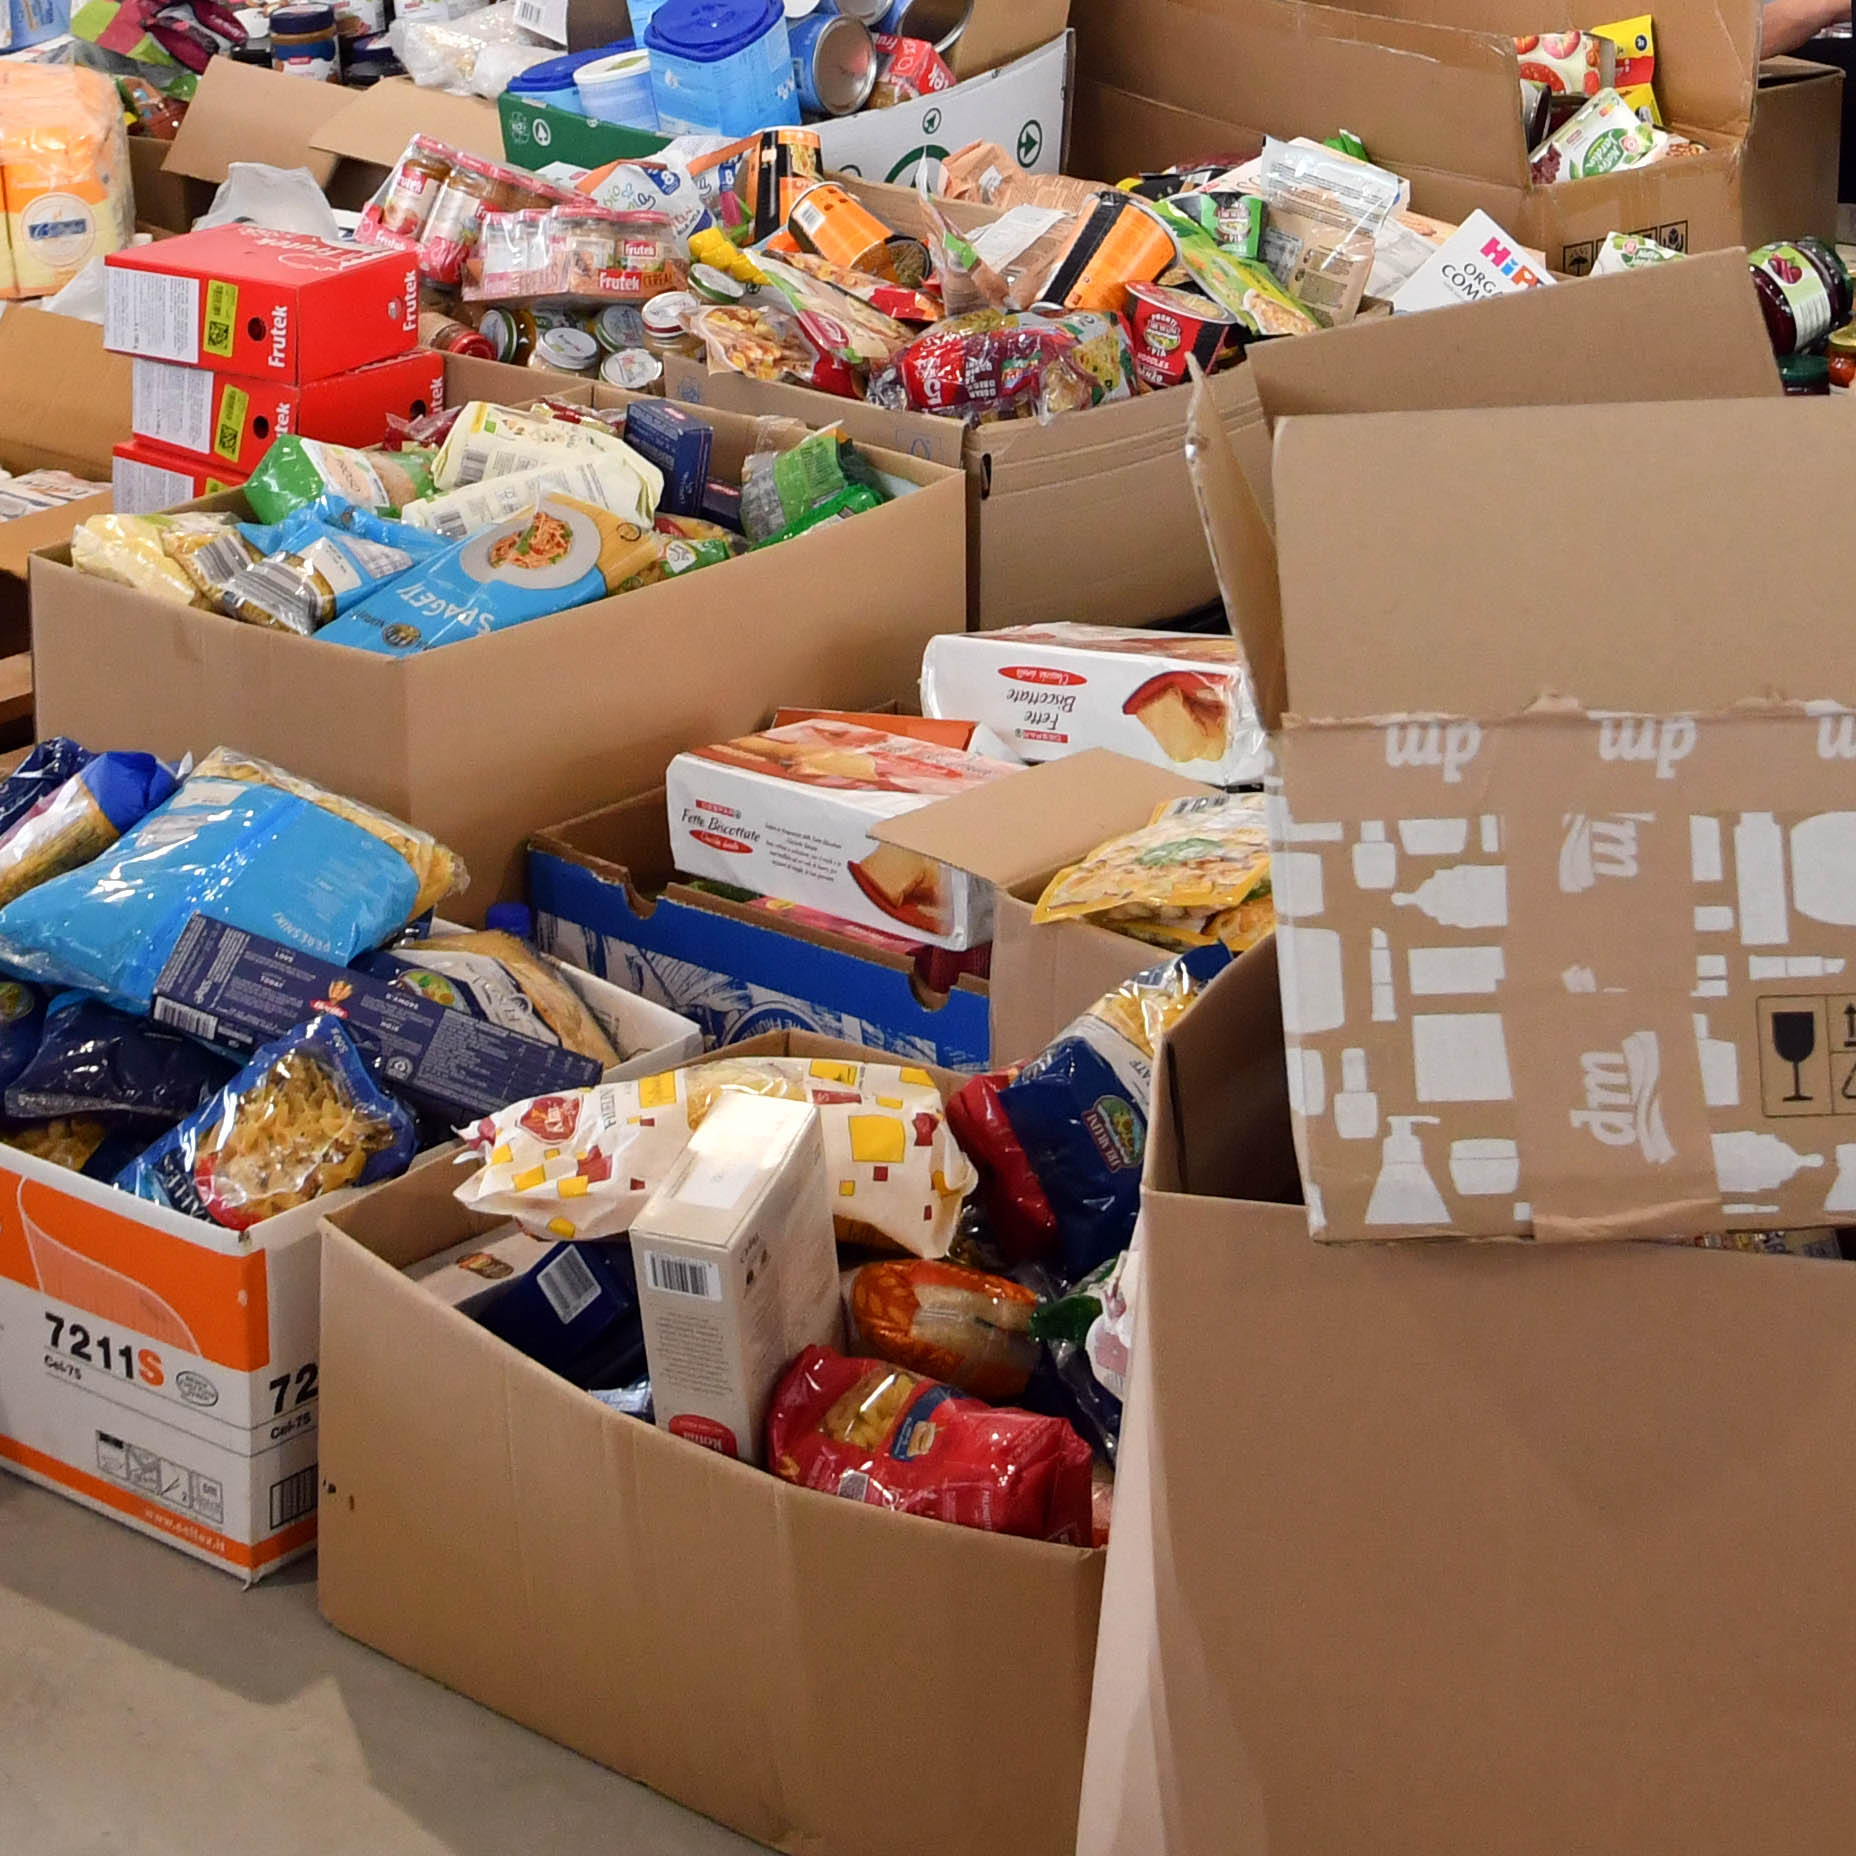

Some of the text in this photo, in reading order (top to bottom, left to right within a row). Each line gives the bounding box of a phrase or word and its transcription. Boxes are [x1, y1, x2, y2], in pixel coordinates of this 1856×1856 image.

[402, 268, 417, 333] Frutek
[598, 270, 641, 291] Frutek
[267, 305, 287, 369] Frutek
[428, 375, 444, 424] utek
[1005, 687, 1077, 713] Biscottate
[1024, 710, 1060, 731] Fette
[1597, 717, 1698, 779] dm
[680, 807, 761, 844] Fette Biscottate
[1570, 1049, 1638, 1145] dm
[45, 1312, 165, 1387] 7211S
